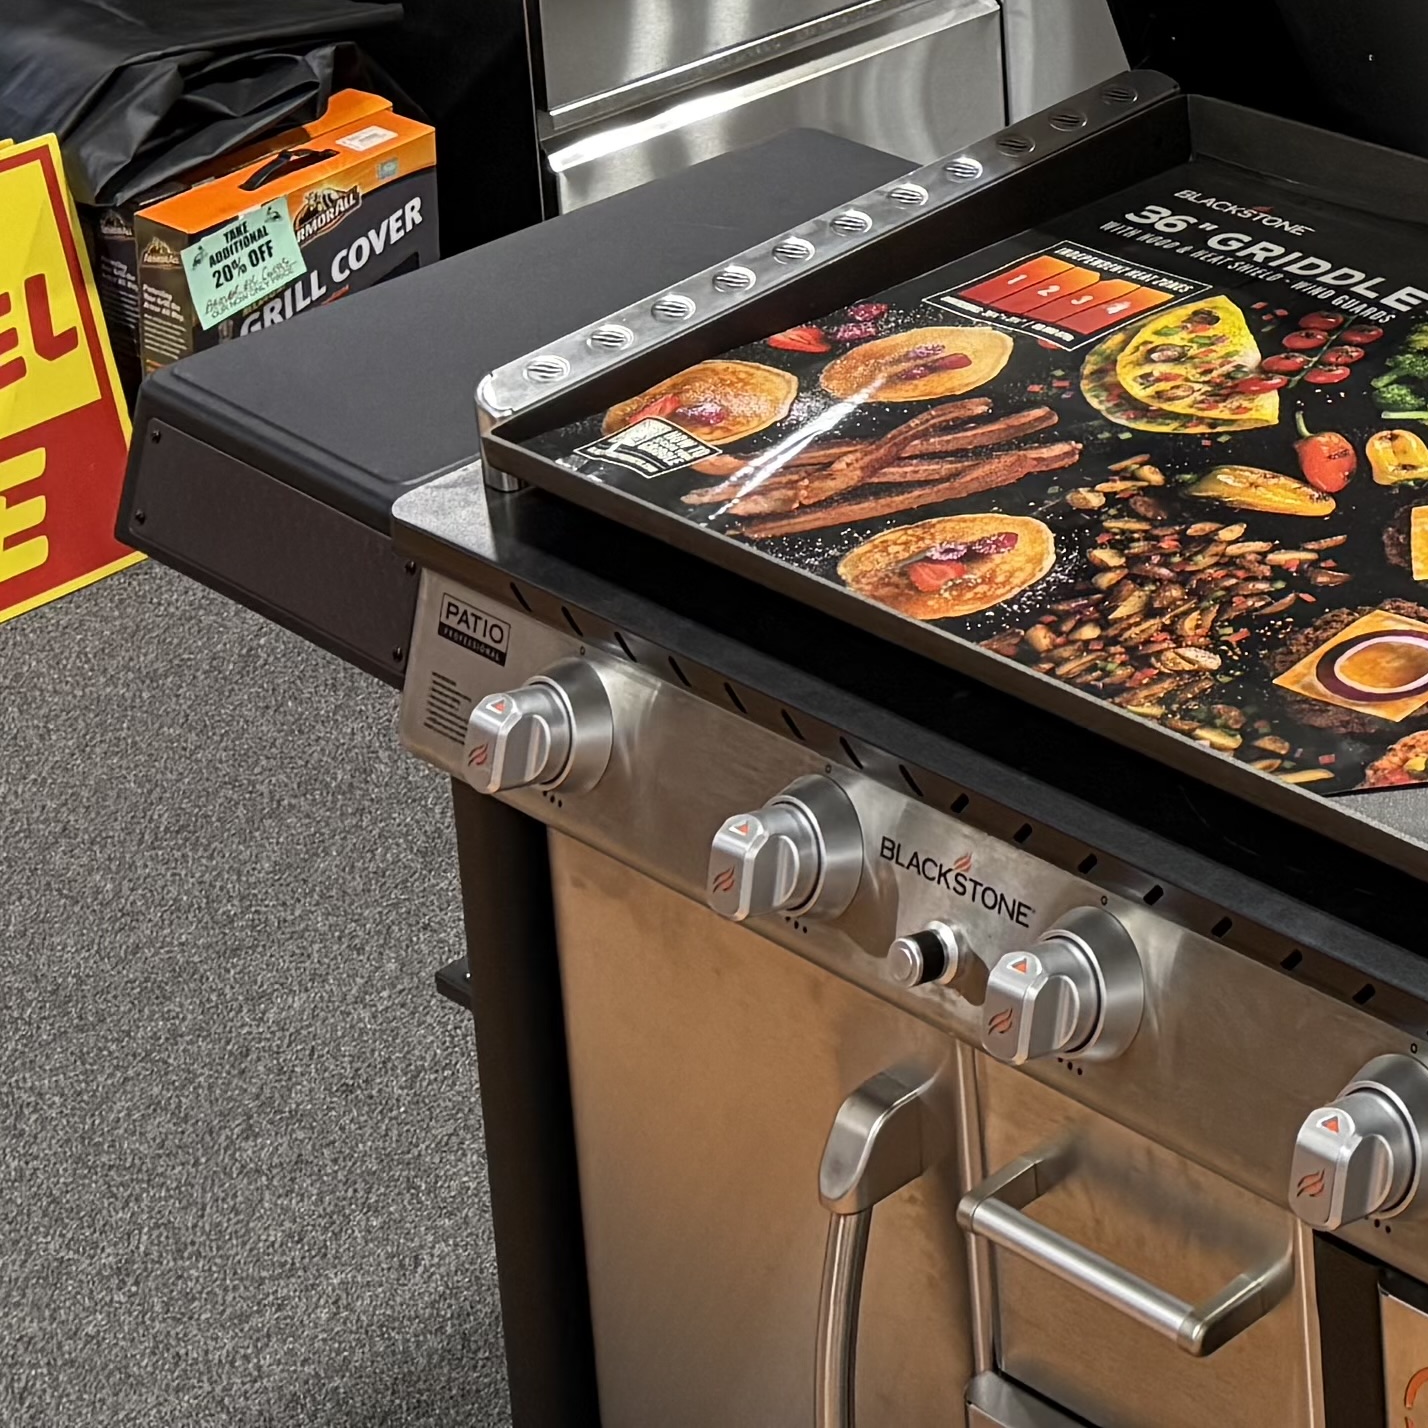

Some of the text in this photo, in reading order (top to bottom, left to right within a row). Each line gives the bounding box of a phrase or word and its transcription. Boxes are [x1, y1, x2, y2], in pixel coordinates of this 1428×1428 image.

[223, 220, 249, 242] TAKE
[1174, 189, 1316, 237] BLACKSTONE
[208, 225, 269, 268] ADDITIONAL
[331, 194, 424, 284] COVER
[212, 239, 274, 289] 20% OFF
[1100, 221, 1138, 244] WITH
[1138, 230, 1176, 251] HOOD
[1189, 245, 1231, 268] HEAT
[1229, 255, 1286, 283] SHIELD
[1290, 279, 1332, 302] WIND
[1331, 295, 1396, 324] GUARDS
[443, 624, 501, 660] PROFESSIONAL
[446, 602, 504, 644] PATIO
[881, 836, 1036, 929] BLACKSTONE
